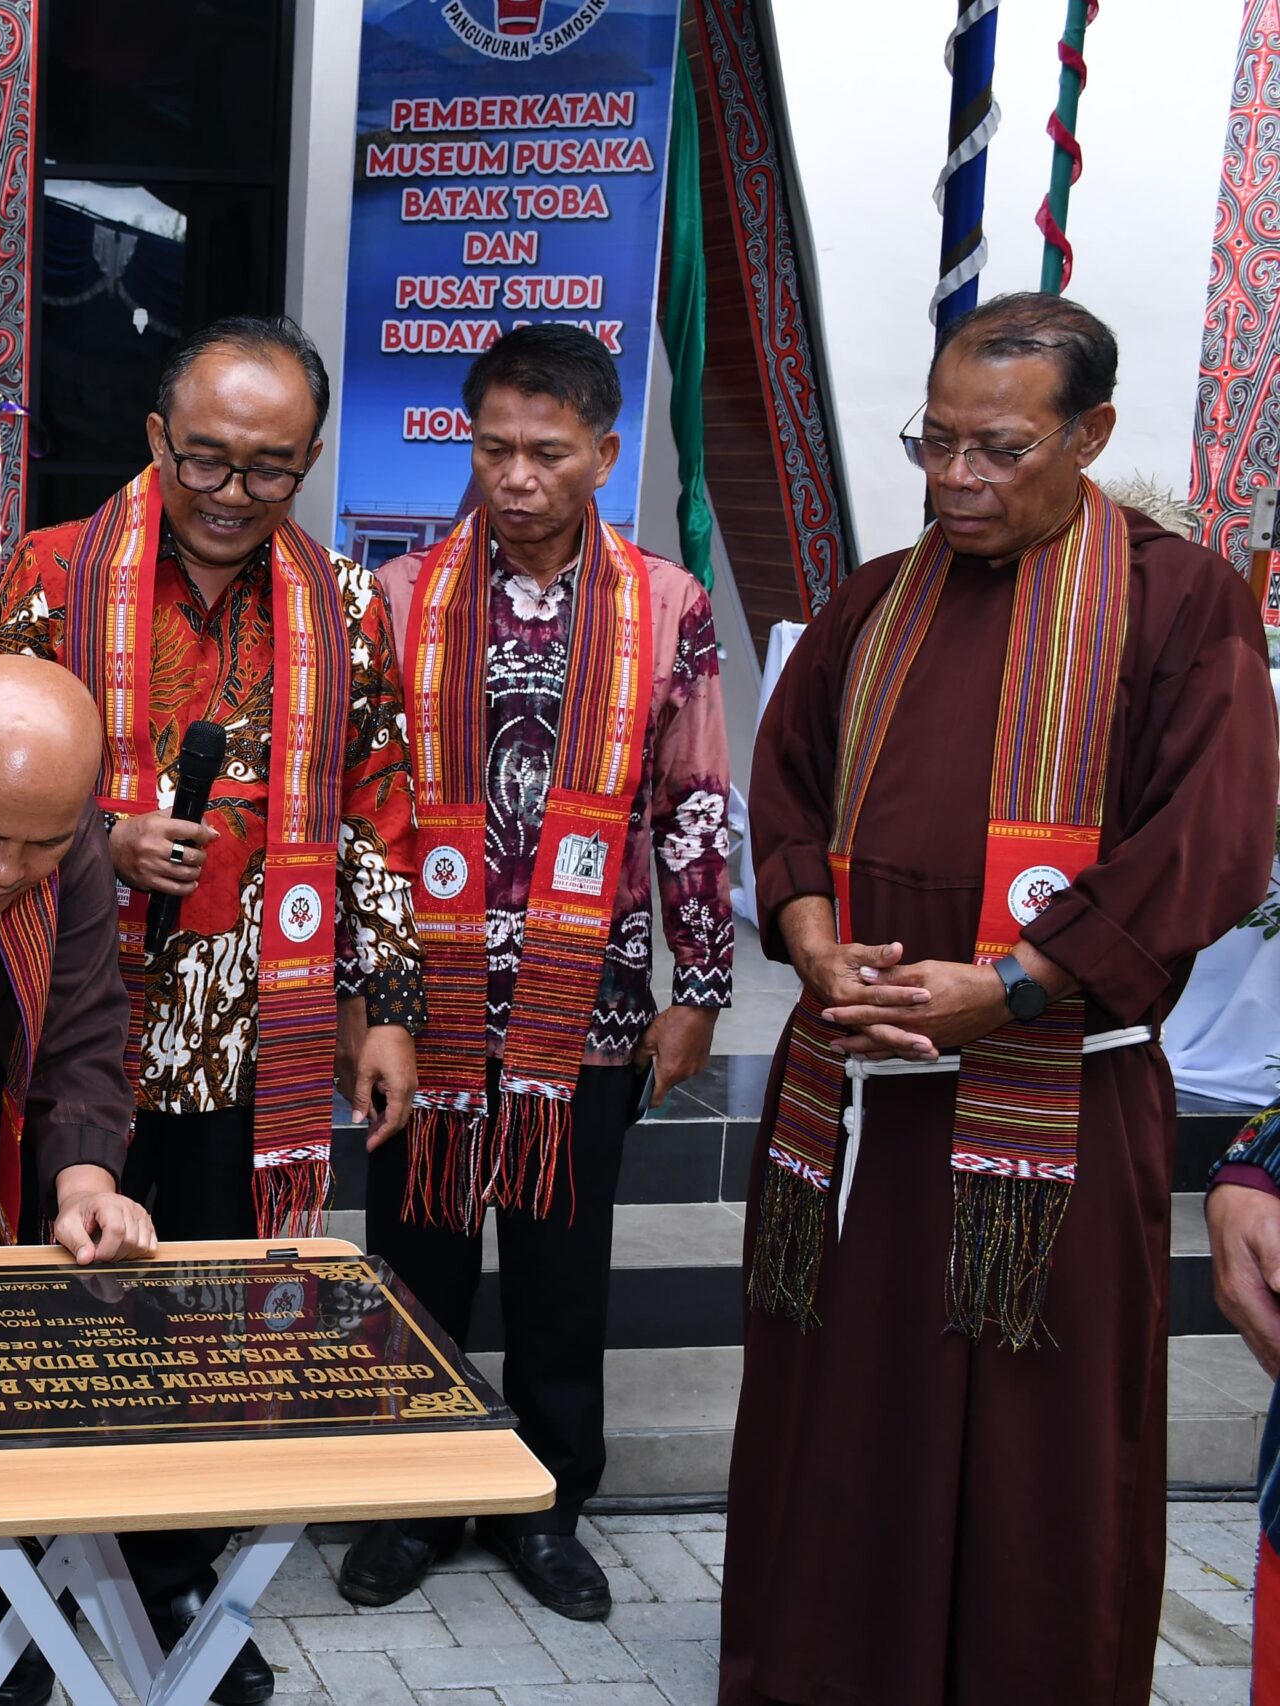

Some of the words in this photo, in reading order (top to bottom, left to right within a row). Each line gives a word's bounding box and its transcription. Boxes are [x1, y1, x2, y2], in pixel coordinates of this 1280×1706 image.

[445, 2, 530, 58] PANGURURAN
[543, 0, 606, 52] SAMOSIR
[392, 93, 633, 131] PEMBERKATAN
[368, 143, 507, 175] MUSEUM
[514, 139, 652, 173] PUSAKA
[402, 188, 508, 219] BATAK
[515, 185, 607, 217] TOBA
[465, 233, 536, 263] DAN
[397, 277, 499, 307] PUSAT
[504, 277, 603, 307] STUDI
[383, 322, 501, 352] BUDAYA
[196, 1277, 251, 1286] TIMOTIUS
[46, 1316, 125, 1326] MINISTER
[167, 1312, 245, 1322] SAMOSIR
[248, 1311, 305, 1320] BUPATI
[79, 1328, 138, 1337] OLEH:
[164, 1334, 218, 1345] PADA
[221, 1330, 342, 1344] DIRESMIKAN
[41, 1340, 63, 1349] 18
[68, 1337, 162, 1348] TANGGAL
[103, 1350, 200, 1368] STUDI
[206, 1346, 305, 1365] PUSAT
[311, 1344, 376, 1361] DAN
[158, 1368, 300, 1389] MUSEUM
[304, 1364, 435, 1384] GEDUNG
[25, 1374, 154, 1393] PUSAKA
[91, 1395, 181, 1408] TUHAN
[187, 1391, 294, 1405] RAHMAT
[302, 1386, 409, 1401] DENGAN
[13, 1399, 87, 1411] YANG
